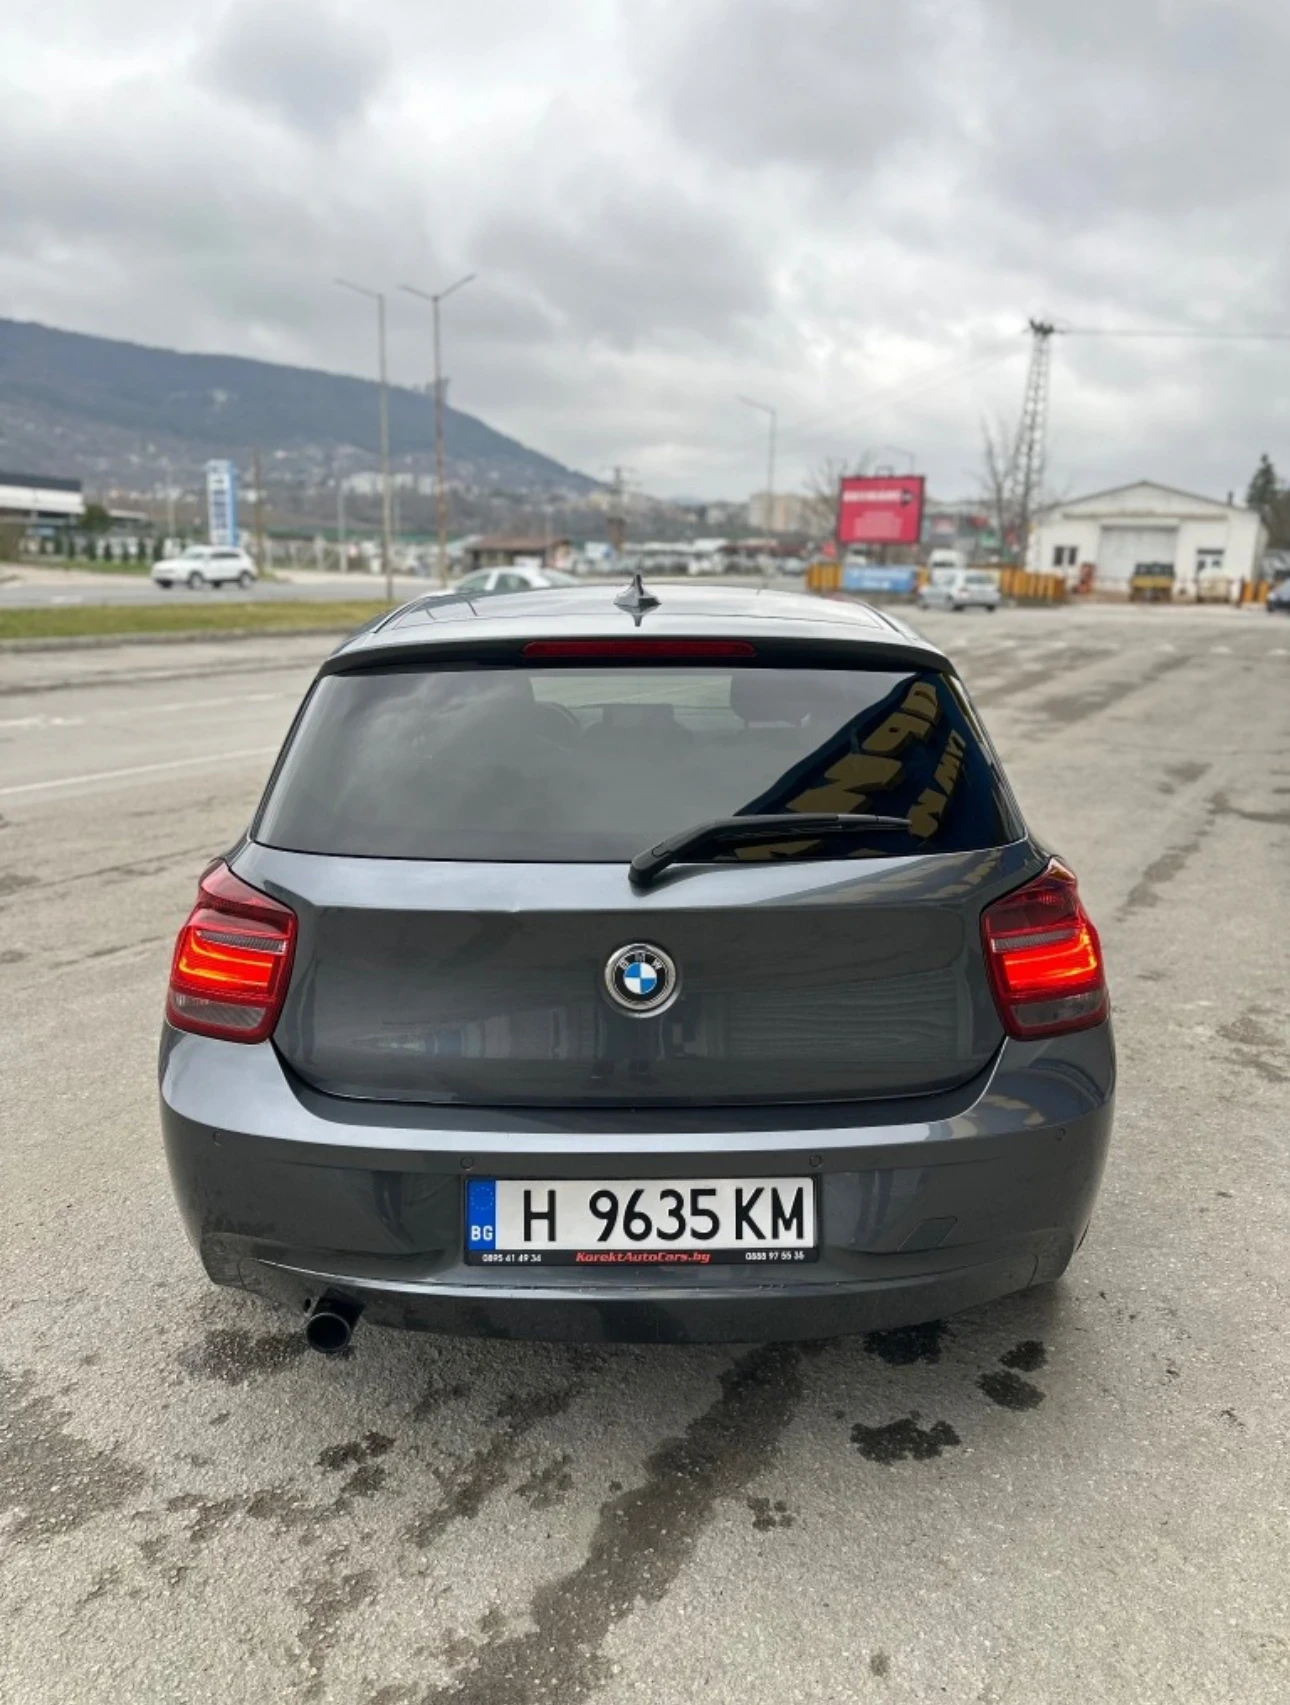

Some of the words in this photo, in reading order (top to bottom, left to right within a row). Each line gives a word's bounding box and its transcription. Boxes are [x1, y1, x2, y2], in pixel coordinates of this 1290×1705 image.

[523, 1189, 556, 1241] H
[588, 1188, 720, 1241] 9635
[735, 1187, 804, 1240] KM
[471, 1225, 494, 1241] BG
